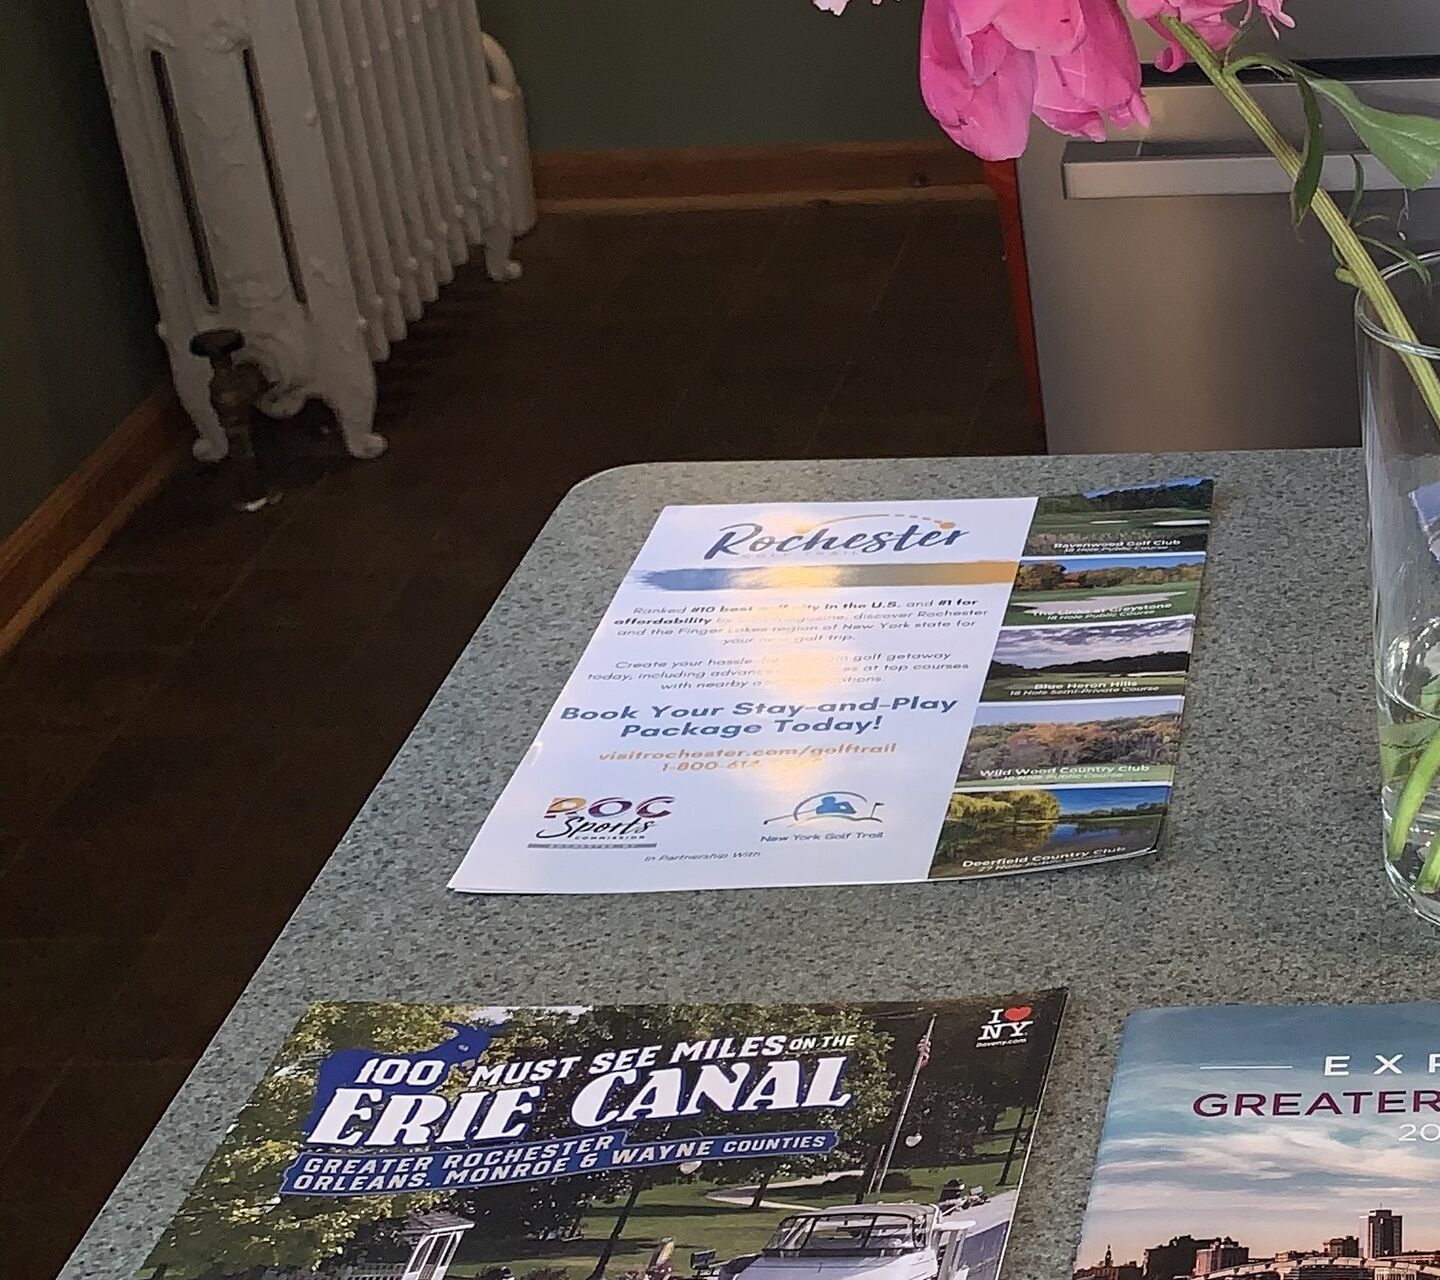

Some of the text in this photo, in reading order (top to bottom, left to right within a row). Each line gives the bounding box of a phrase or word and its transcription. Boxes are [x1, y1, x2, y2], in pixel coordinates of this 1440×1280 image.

[704, 522, 970, 560] Rochester
[1054, 542, 1124, 550] Ravenwood
[634, 607, 687, 615] Ranked
[871, 601, 900, 609] U.S.
[937, 599, 952, 607] #1
[956, 598, 979, 606] for
[613, 609, 988, 626] affordability discover Rochester
[617, 628, 647, 636] and
[651, 627, 673, 635] the
[678, 627, 723, 636] Finger
[880, 621, 909, 629] York
[956, 620, 977, 628] for
[828, 634, 856, 642] trip.
[615, 661, 667, 669] Create
[672, 660, 702, 669] your
[853, 653, 882, 662] golf
[886, 652, 952, 661] getaway
[587, 672, 633, 682] today,
[638, 670, 706, 680] including
[884, 664, 908, 673] top
[913, 663, 969, 671] courses
[661, 681, 692, 690] with
[696, 680, 749, 689] nearby
[1023, 689, 1048, 697] Hole
[1050, 688, 1120, 696] Semi-Private
[1034, 682, 1063, 690] Blue
[1068, 681, 1107, 689] Heron
[561, 696, 959, 721] Book Your Stay-and-Play
[620, 716, 883, 740] Package Today!
[599, 743, 897, 761] visitrochester.com/golftrail
[980, 764, 1150, 777] Wild Wood Country Club
[544, 796, 675, 818] ROC
[536, 817, 656, 838] Sports
[760, 831, 884, 843] New York Golf Trail
[658, 852, 728, 862] Partnership
[962, 846, 1126, 869] Deerfield Country Club
[987, 1008, 1004, 1024] I
[977, 1021, 1034, 1041] NY
[354, 1034, 858, 1087] 100 MUST SEE MILES ON THE
[306, 1056, 852, 1146] ERIE CANAL
[303, 1134, 614, 1175] GREATER ROCHESTER
[443, 1160, 567, 1186] MONROE
[579, 1155, 599, 1169] &
[611, 1140, 714, 1165] WAYNE
[723, 1135, 827, 1154] COUNTIES
